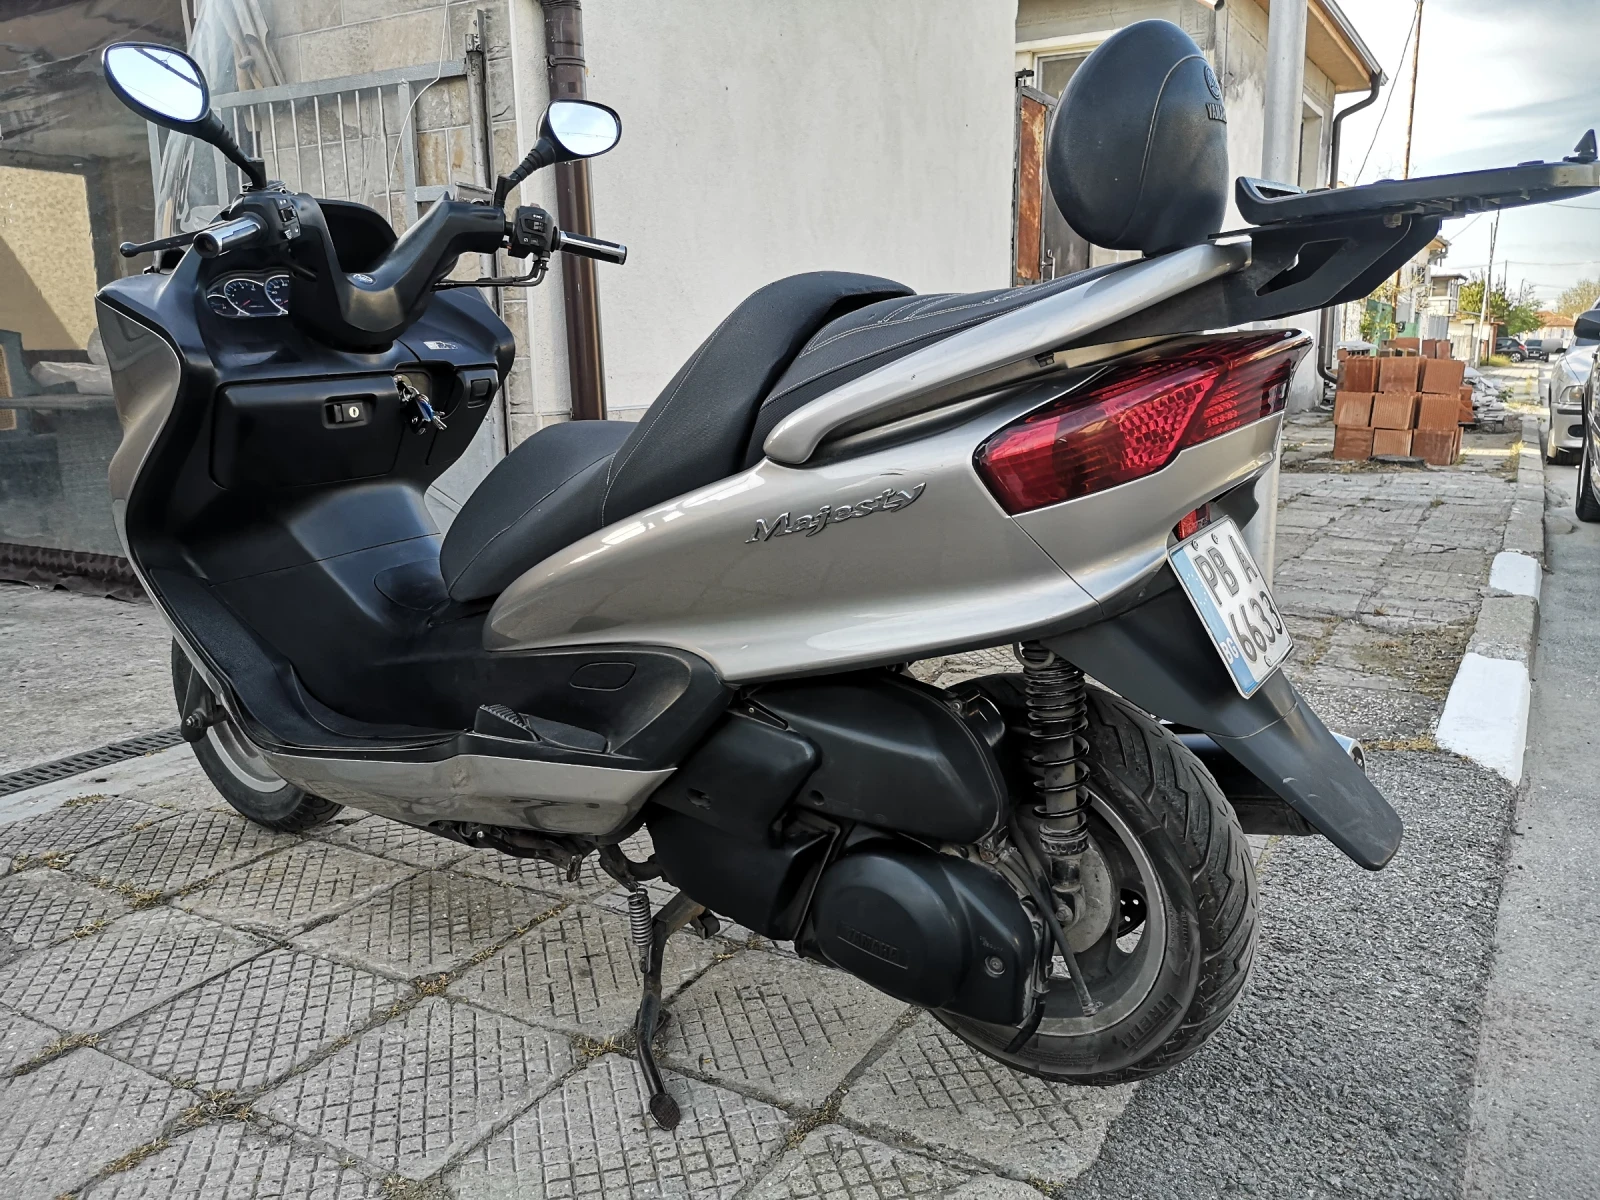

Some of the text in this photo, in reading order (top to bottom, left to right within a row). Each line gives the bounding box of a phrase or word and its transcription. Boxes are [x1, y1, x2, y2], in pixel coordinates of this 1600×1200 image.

[744, 482, 926, 544] Majesty
[1193, 535, 1257, 607] PB A
[1220, 637, 1240, 664] BG
[1228, 591, 1282, 662] 6633
